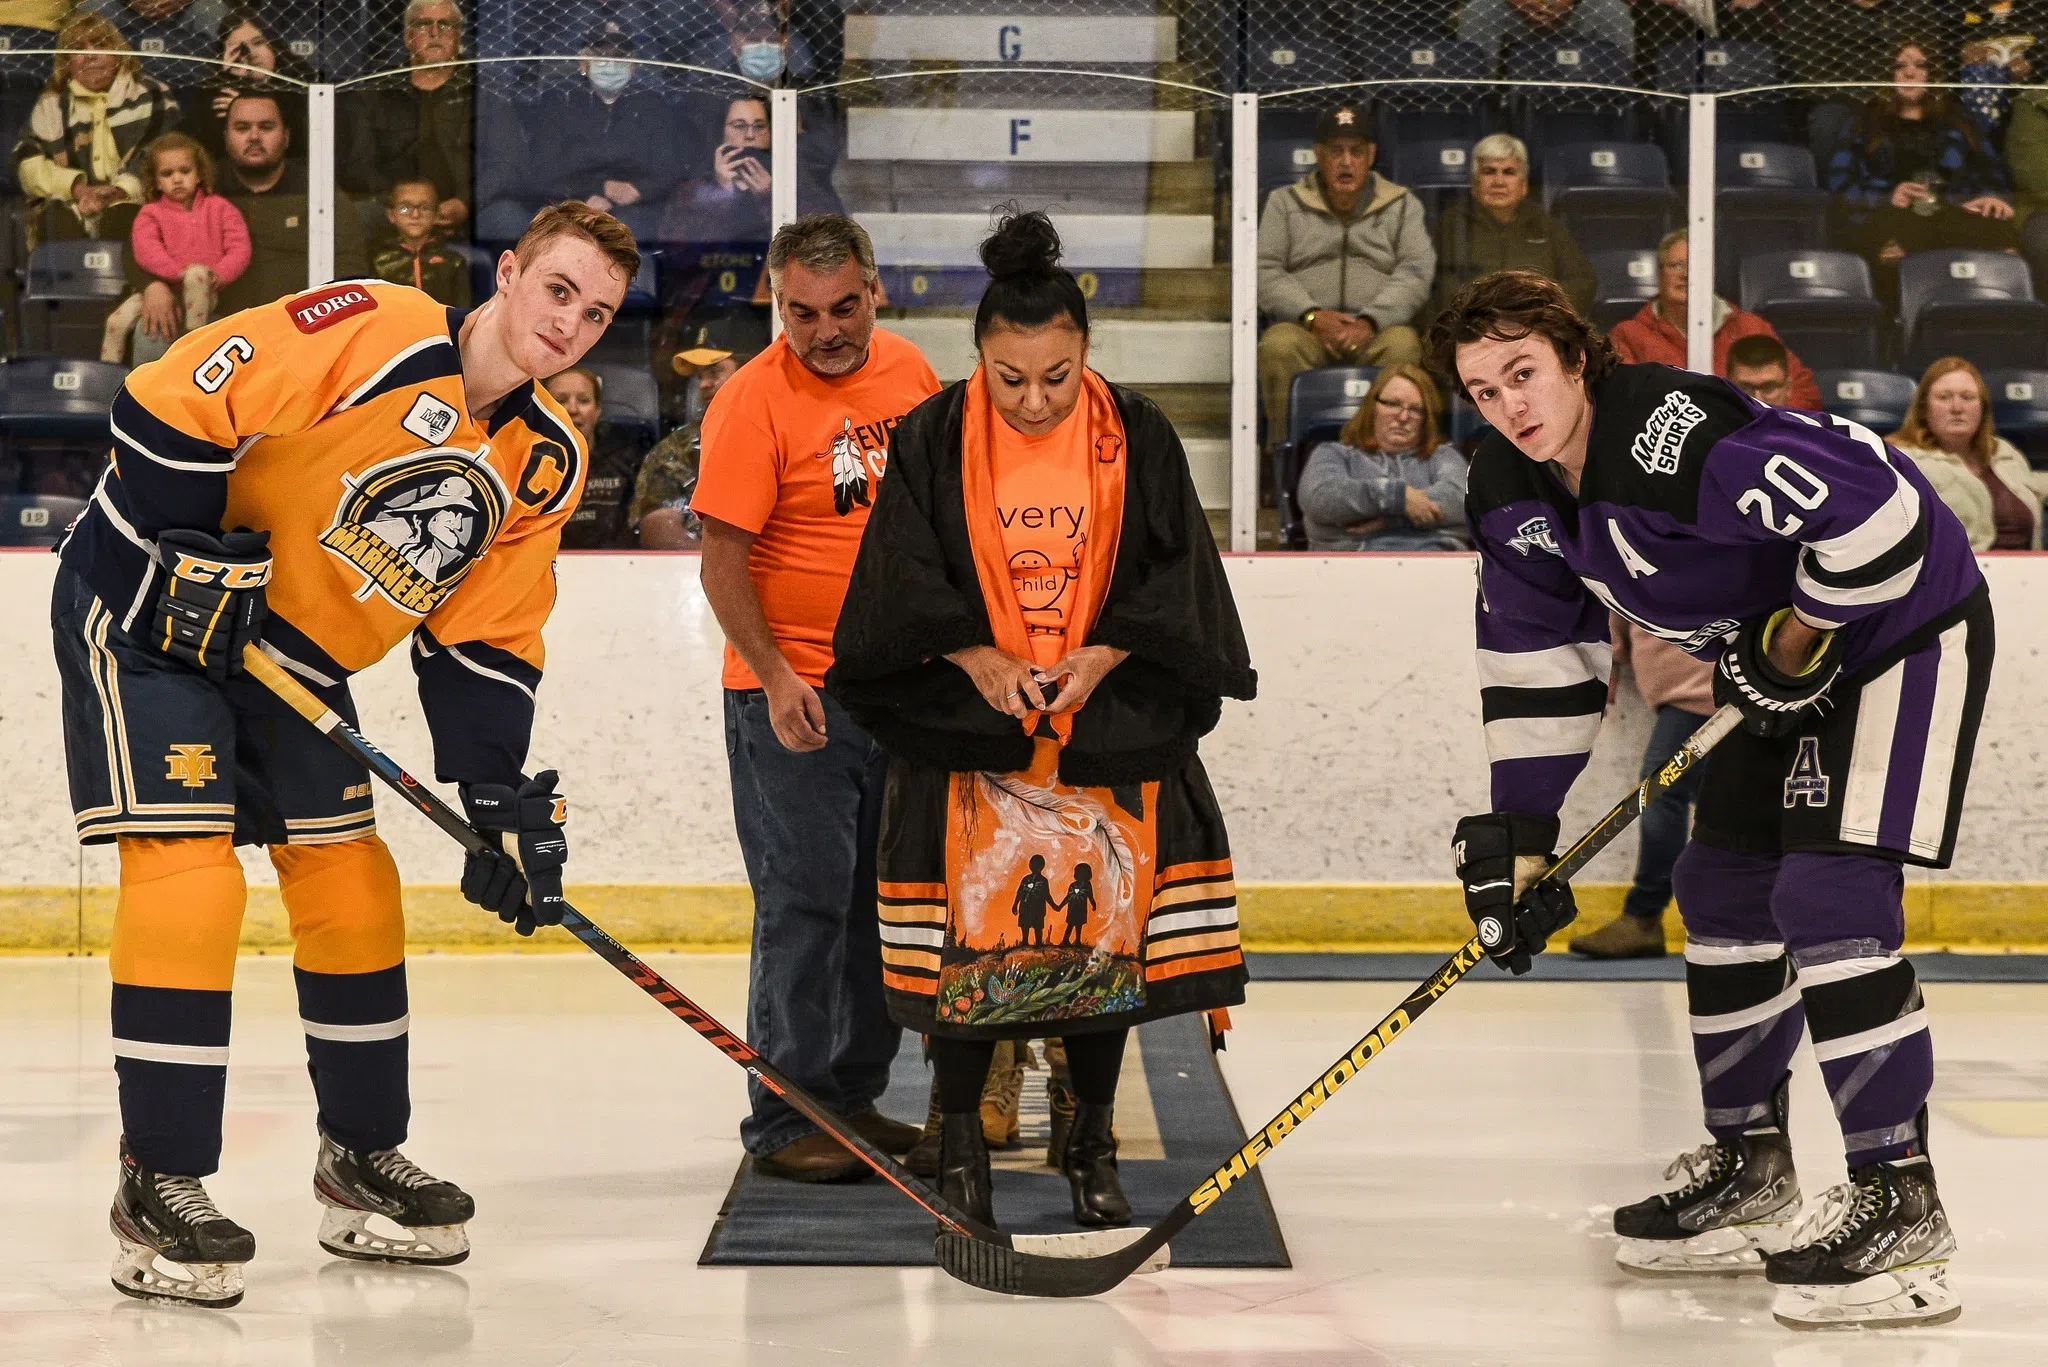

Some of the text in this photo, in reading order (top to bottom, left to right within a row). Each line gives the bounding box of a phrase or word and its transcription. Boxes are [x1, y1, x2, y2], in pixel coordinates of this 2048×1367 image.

[999, 25, 1021, 60] G
[1010, 118, 1031, 155] F
[57, 374, 75, 387] 12
[193, 335, 255, 394] 6
[1657, 406, 1704, 471] SPORTS
[515, 440, 569, 507] C
[1736, 454, 1829, 537] 20
[25, 511, 45, 524] 12
[997, 506, 1084, 539] very
[324, 526, 441, 613] MARINERS
[341, 521, 415, 577] YARMOUTH
[1606, 518, 1659, 579] A
[1784, 736, 1829, 808] A
[475, 798, 500, 807] CCM
[592, 924, 627, 954] COVERT
[1189, 1007, 1411, 1216] SHERWOOD
[1859, 1230, 1899, 1270] BAUER
